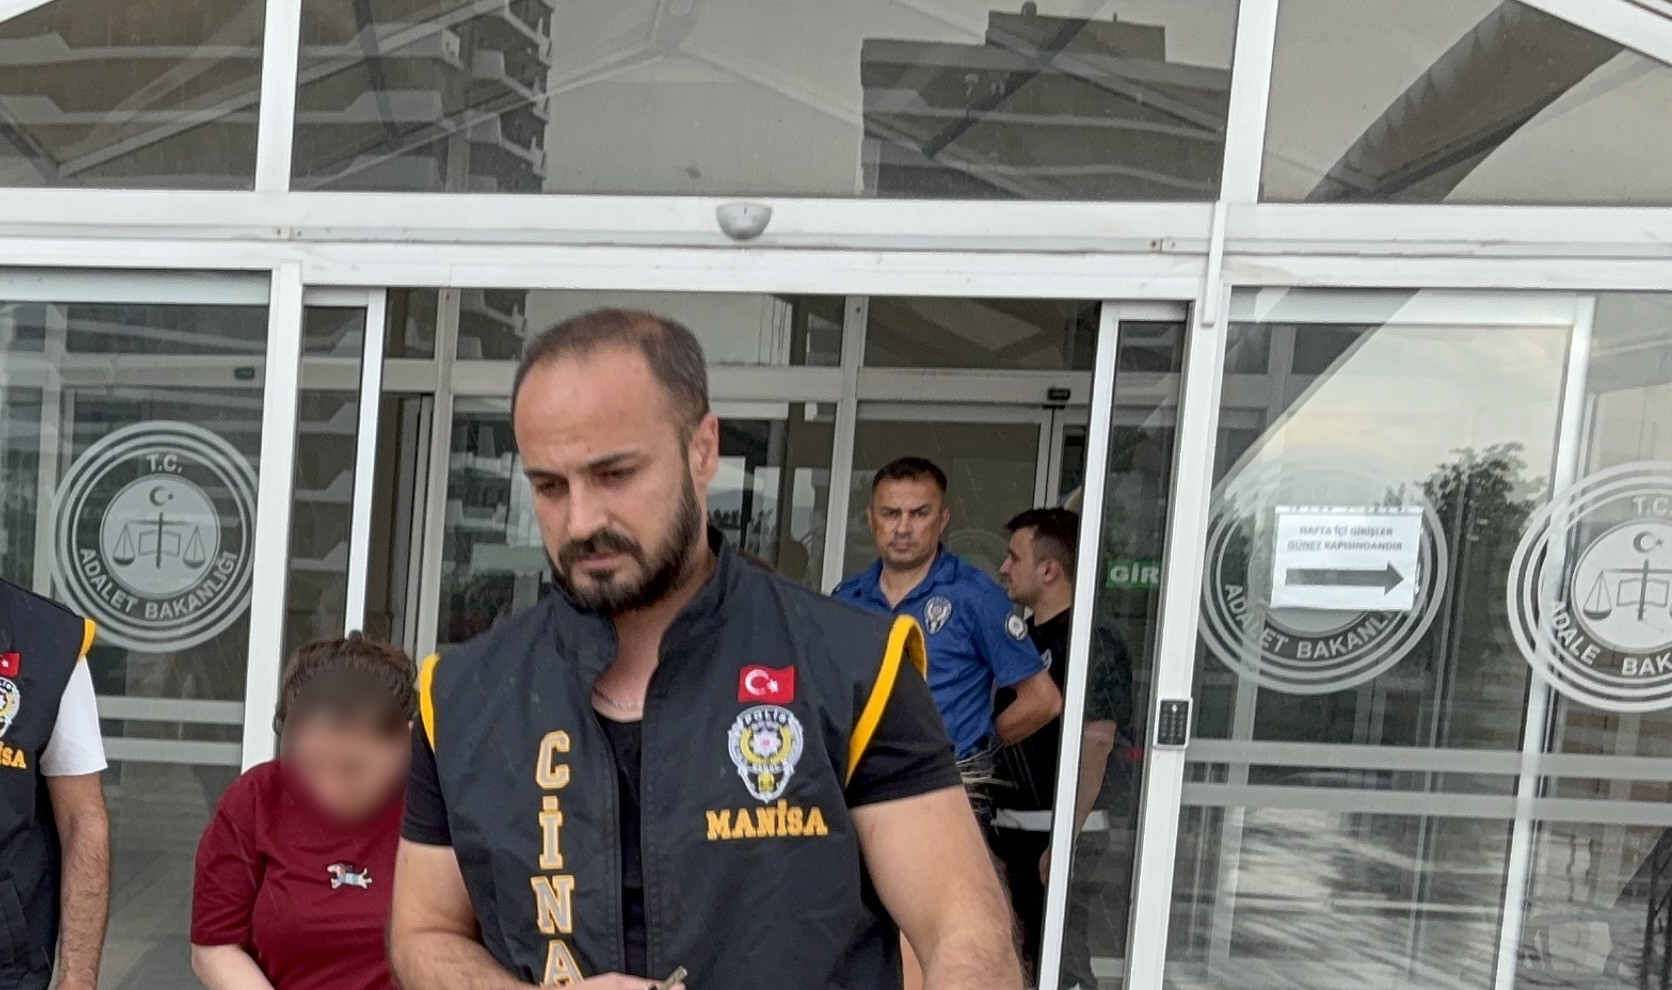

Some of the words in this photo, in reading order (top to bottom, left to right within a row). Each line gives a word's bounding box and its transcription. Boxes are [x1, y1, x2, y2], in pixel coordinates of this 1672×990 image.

[145, 454, 182, 473] T.C.
[1299, 525, 1332, 536] HAFTA
[80, 548, 139, 613] ADALET
[144, 552, 238, 619] BAKANLIĞI
[1110, 562, 1159, 584] GİR
[1296, 611, 1394, 659] BAKANL
[1621, 651, 1672, 676] BAK
[706, 799, 828, 840] MANİSA
